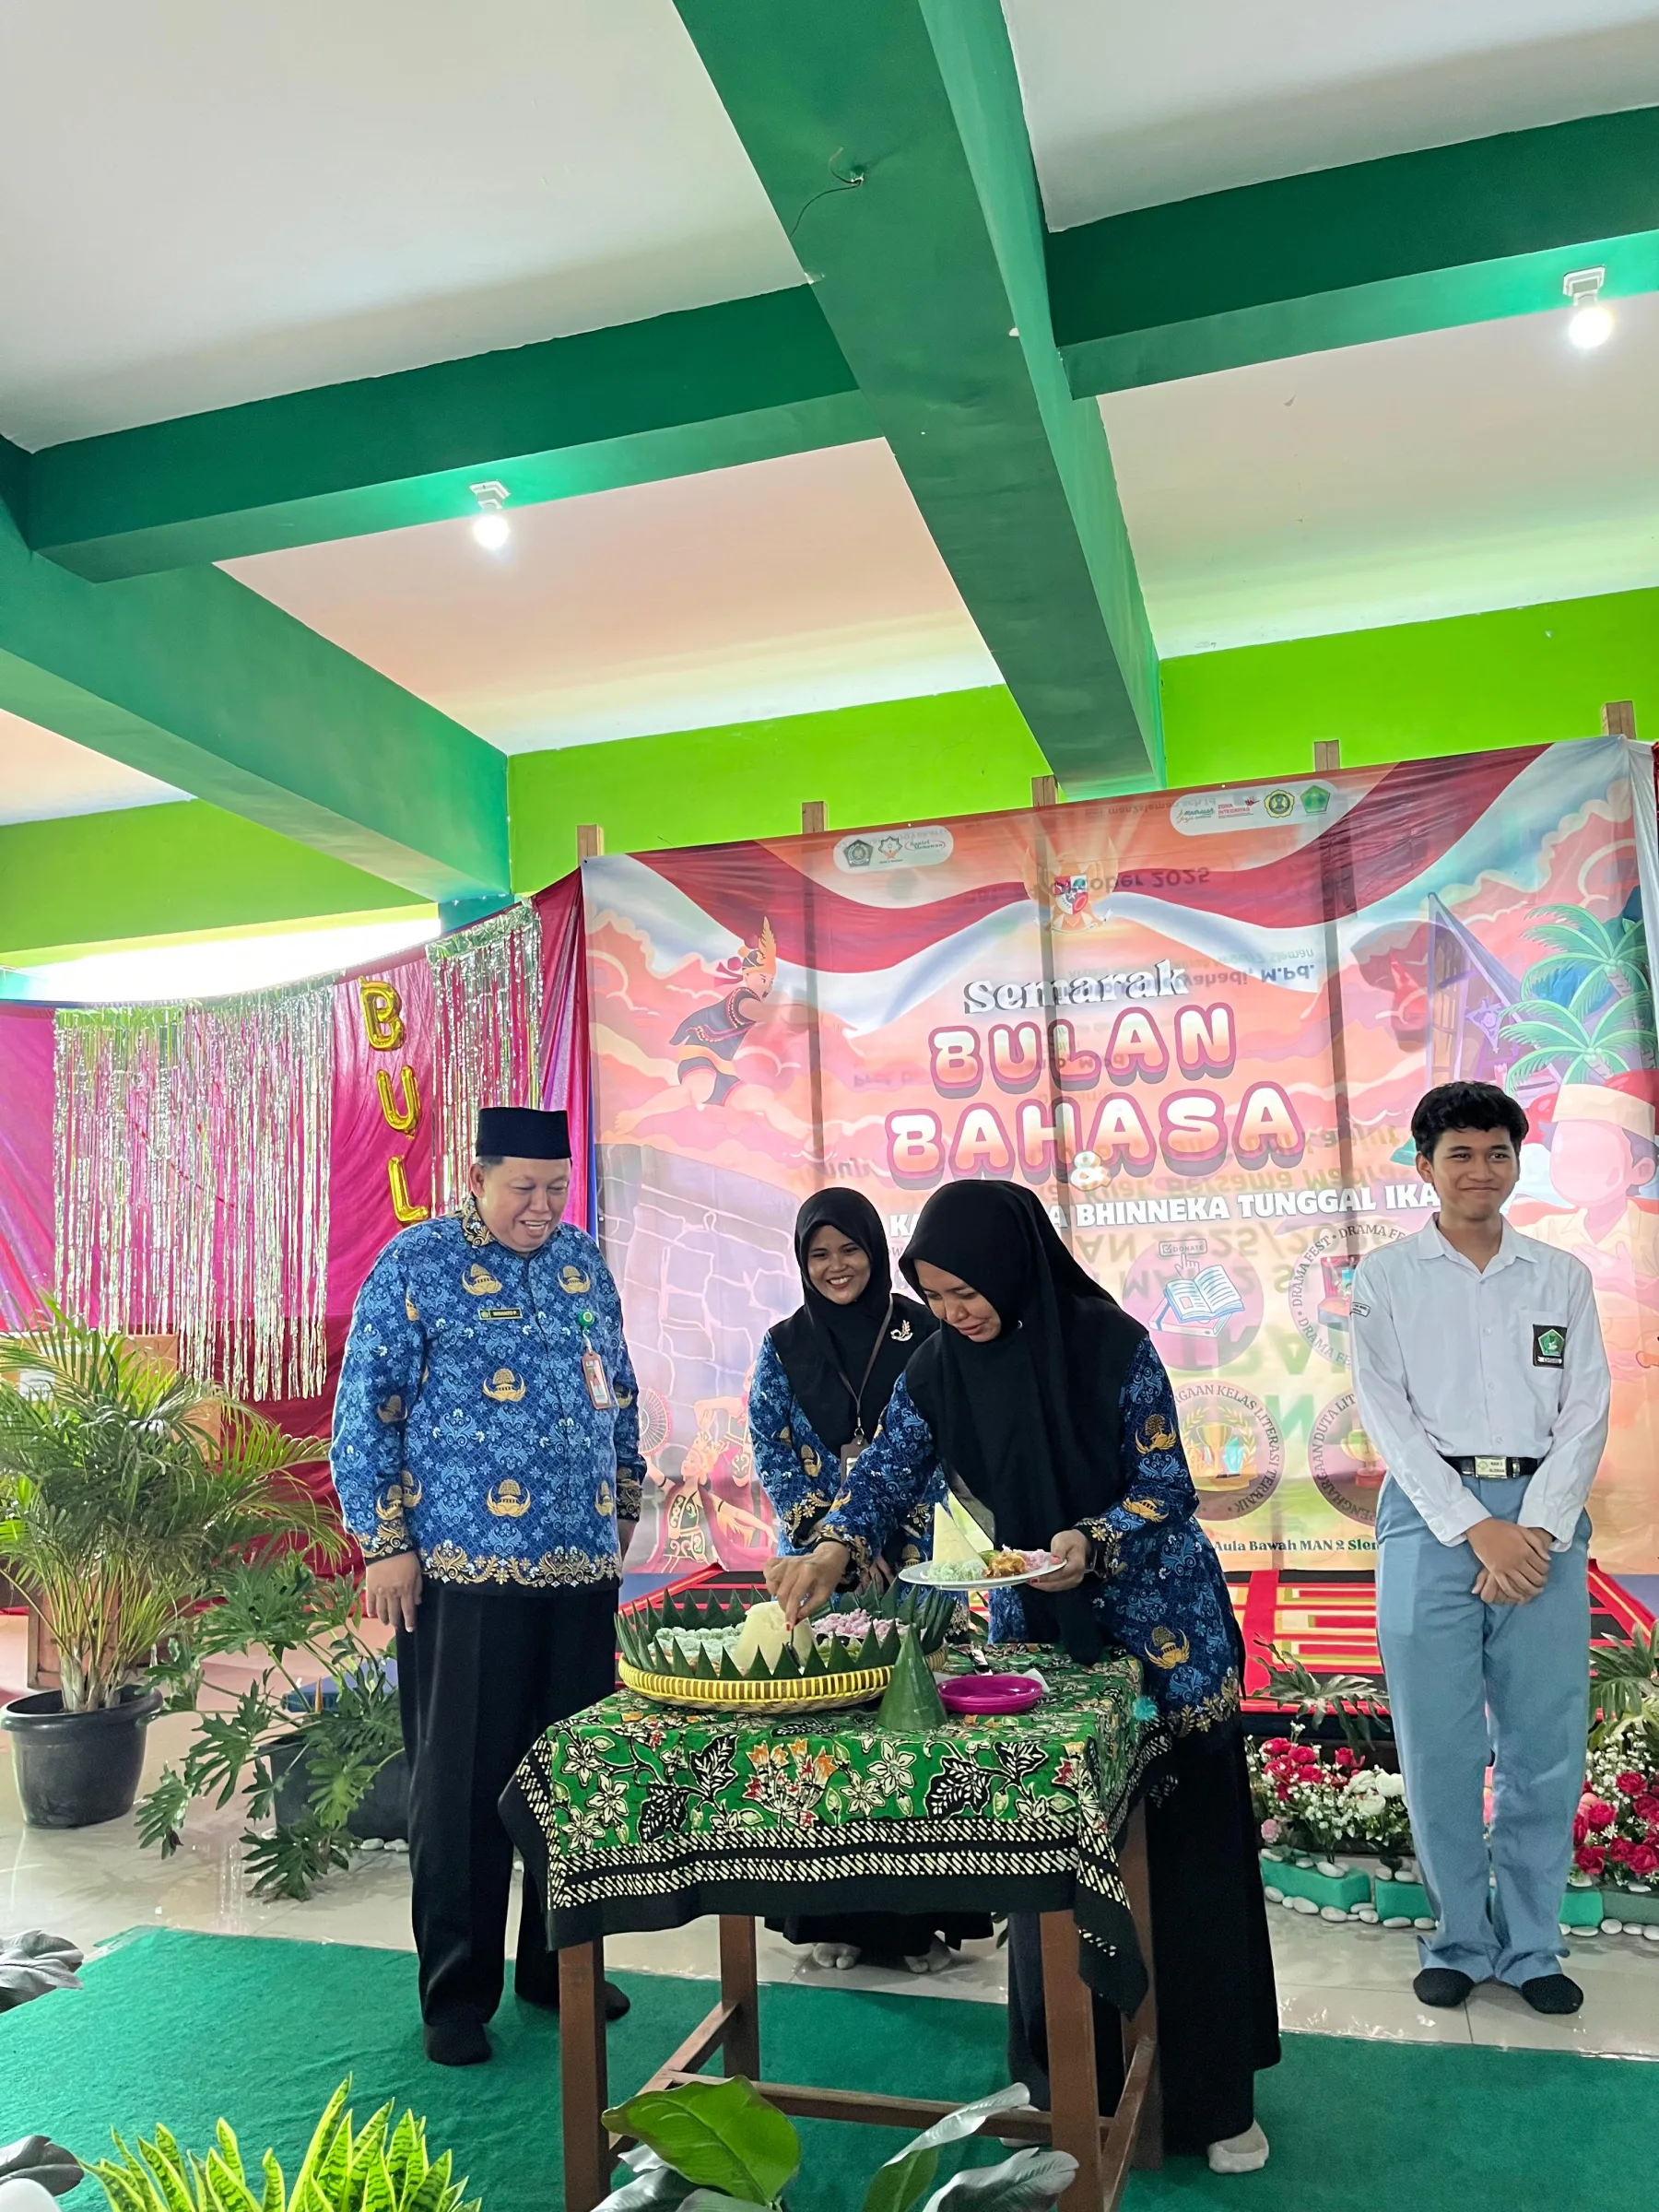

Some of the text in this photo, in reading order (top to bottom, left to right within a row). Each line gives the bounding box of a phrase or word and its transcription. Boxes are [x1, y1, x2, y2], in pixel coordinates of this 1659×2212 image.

[964, 959, 1189, 1014] Semarak
[928, 1003, 1238, 1099] BULAN
[885, 1081, 1306, 1191] BAHASA
[1070, 1150, 1112, 1191] &
[1076, 1195, 1230, 1227] BHINNEKA
[1237, 1186, 1376, 1218] TUNGGAL
[1384, 1182, 1441, 1210] IKA
[1172, 1244, 1205, 1253] DONATE
[1338, 1224, 1387, 1240] DRAMA
[1291, 1235, 1331, 1307] DRAMA FEST
[1298, 1316, 1334, 1358] DRAMA
[1217, 1384, 1257, 1410] KELAS
[1253, 1407, 1280, 1466] LITERASI
[1312, 1410, 1339, 1443] DUTA
[1214, 1538, 1379, 1551] Aula Bawah MAN 2 Sle
